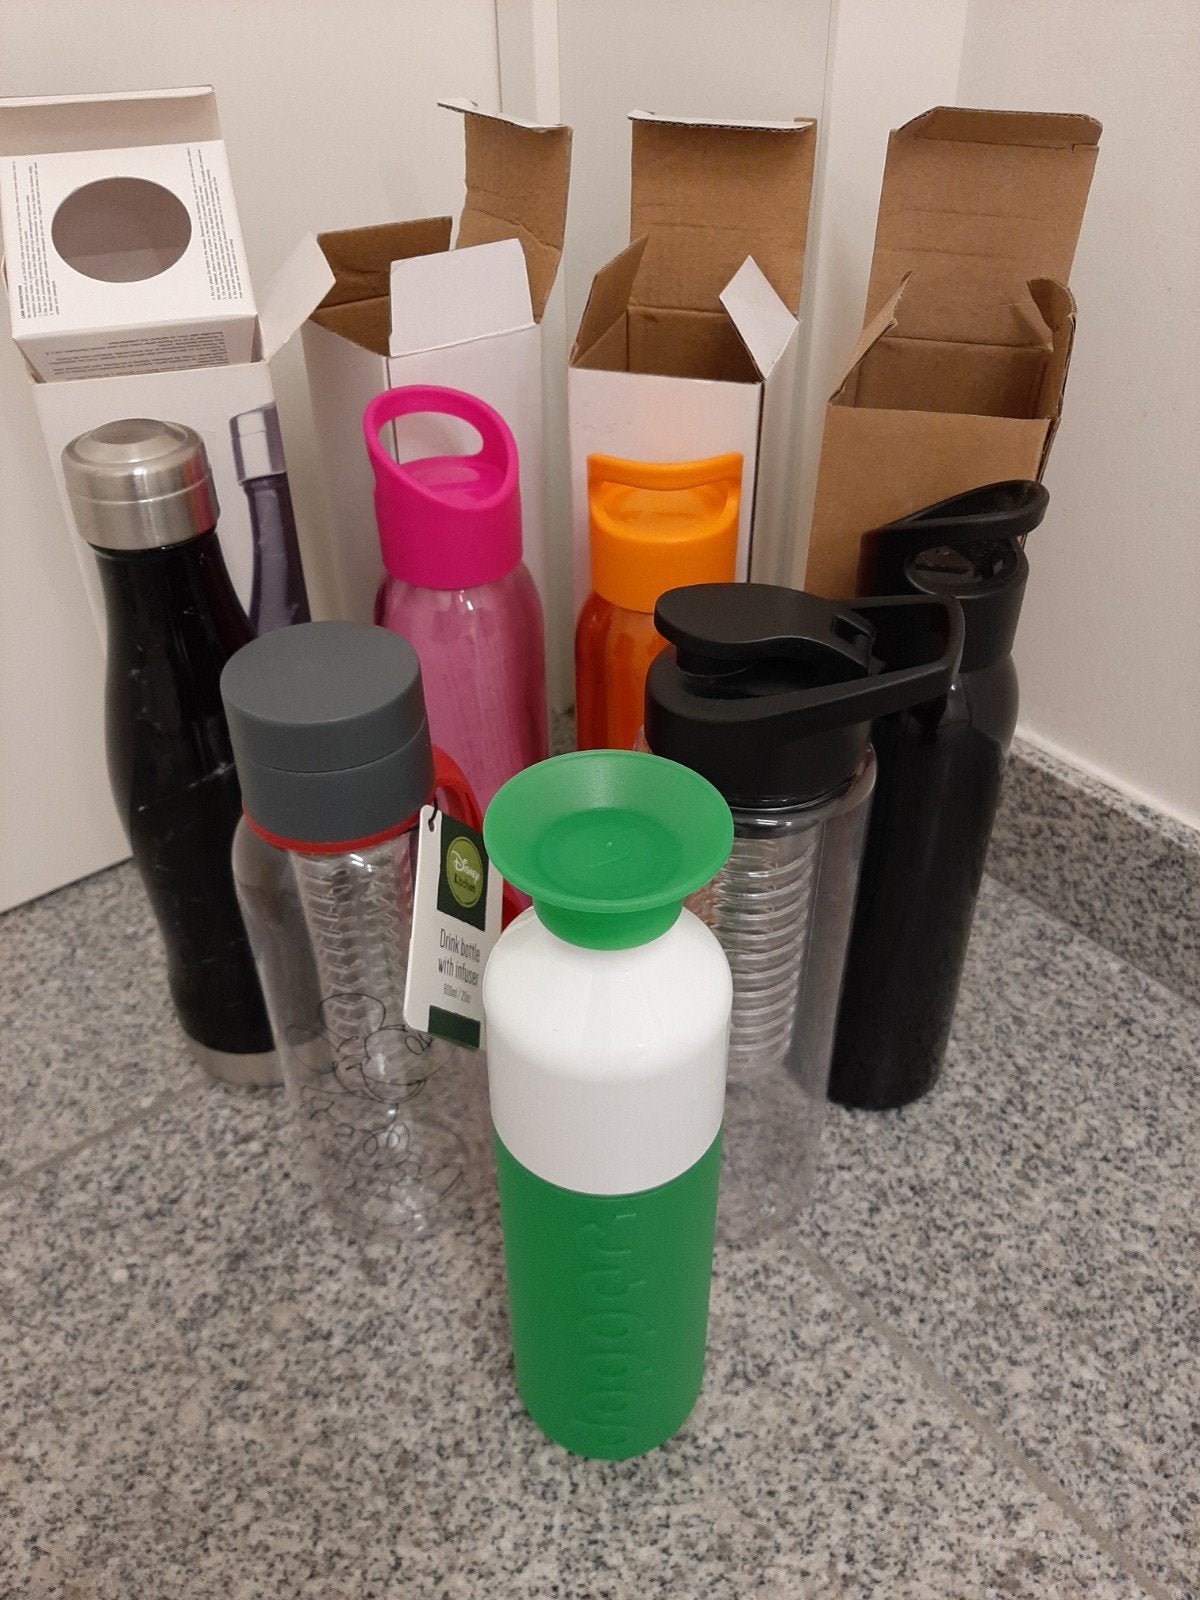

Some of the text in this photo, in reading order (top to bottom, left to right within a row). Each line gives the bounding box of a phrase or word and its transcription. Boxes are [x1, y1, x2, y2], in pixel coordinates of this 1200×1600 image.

[450, 850, 481, 884] Disney
[453, 874, 477, 893] Kitchen
[440, 928, 481, 963] Drink bottle
[438, 957, 480, 987] with infuser
